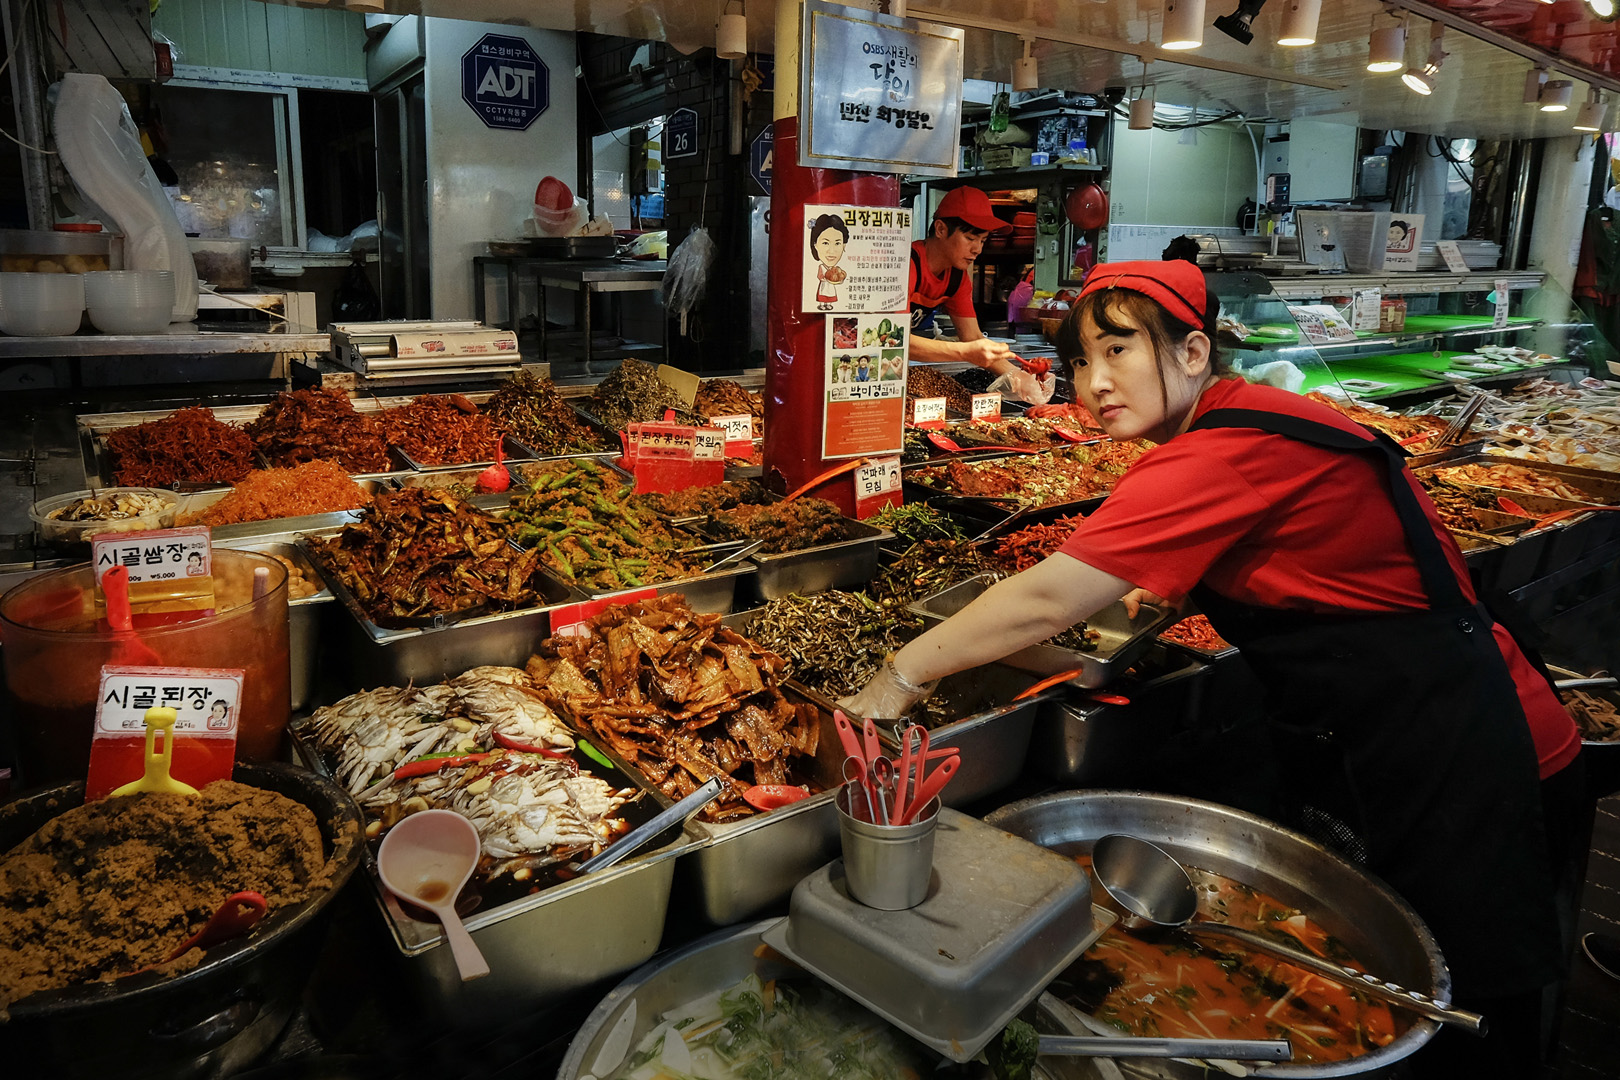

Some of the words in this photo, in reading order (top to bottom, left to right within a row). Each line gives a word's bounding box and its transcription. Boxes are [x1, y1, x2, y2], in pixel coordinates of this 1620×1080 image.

[870, 44, 885, 55] SBS
[885, 45, 918, 69] 생활의
[477, 65, 535, 100] ADT
[675, 132, 689, 151] 26
[844, 209, 892, 228] 김장김치
[896, 212, 910, 229] 재료
[862, 465, 886, 481] 건파래
[866, 480, 882, 493] 무침
[98, 543, 188, 567] 시골쌈장
[104, 685, 213, 710] 시골된장
